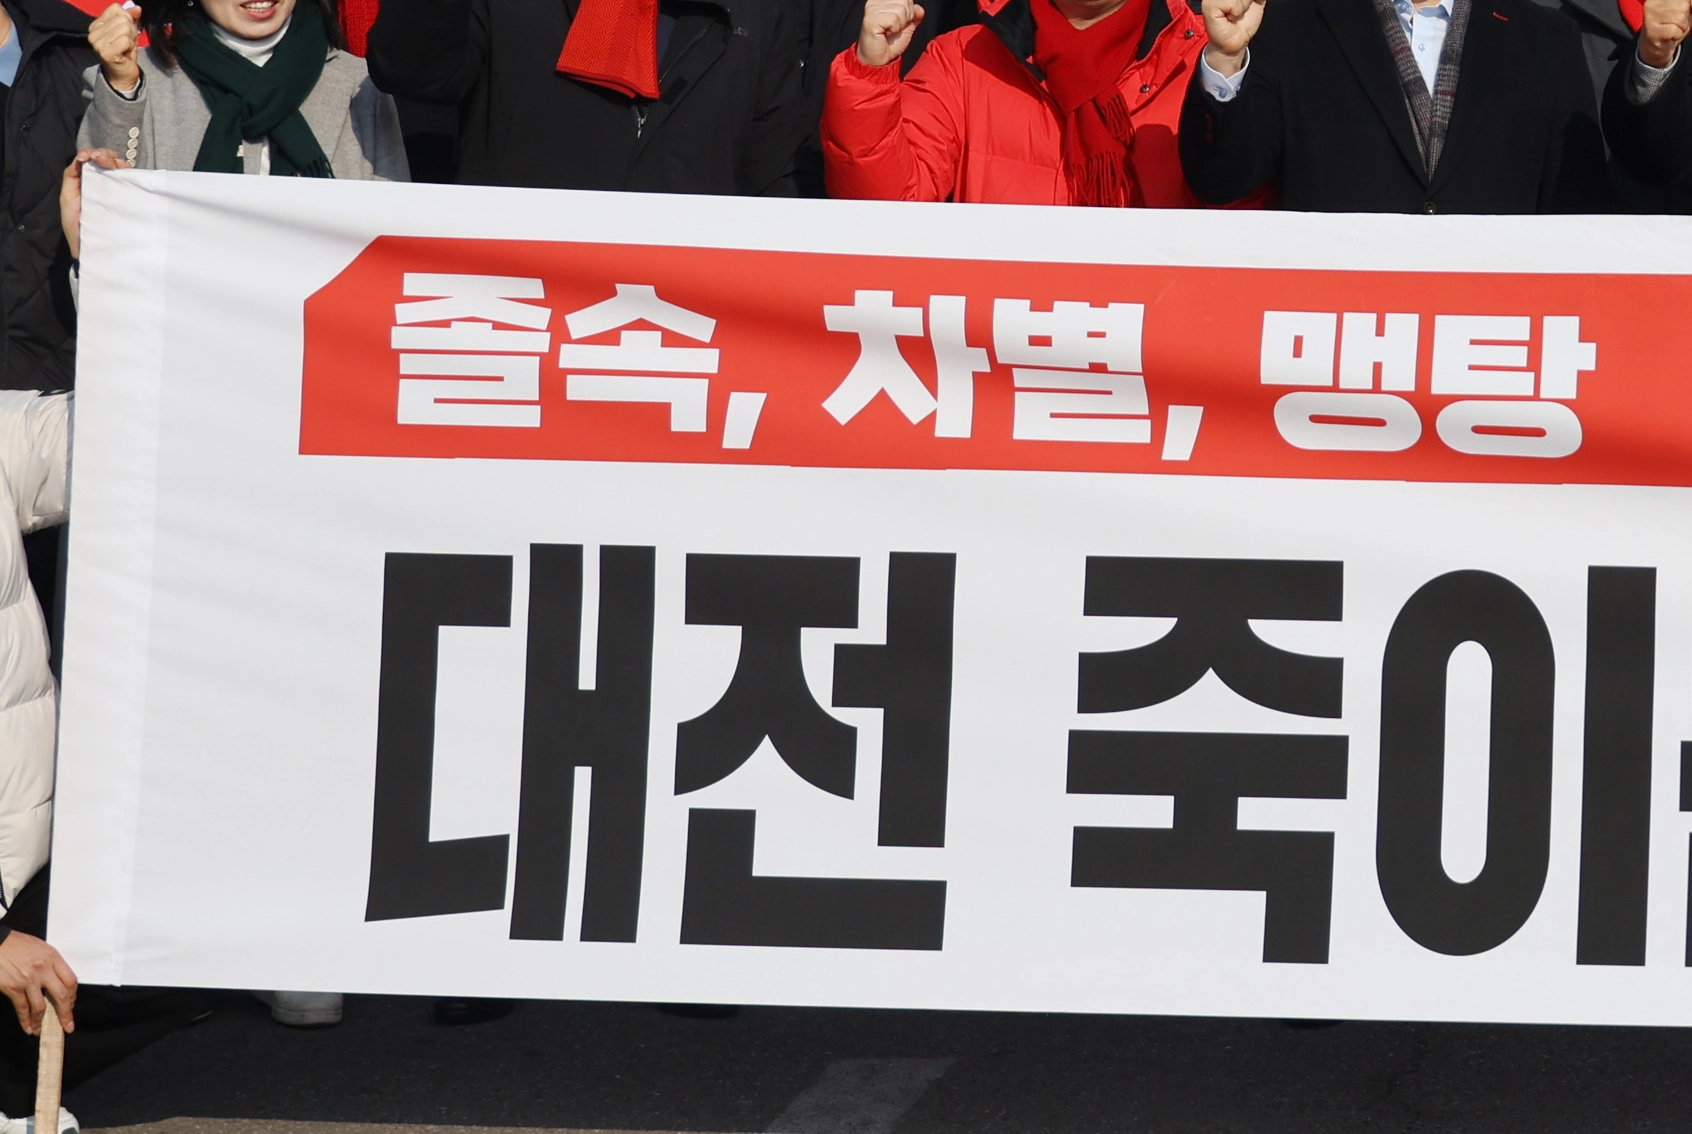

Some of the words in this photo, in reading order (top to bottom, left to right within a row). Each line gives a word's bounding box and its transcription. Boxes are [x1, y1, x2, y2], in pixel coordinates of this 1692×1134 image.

[390, 272, 768, 450] 졸속,
[821, 289, 1204, 461] 차별,
[1260, 310, 1597, 458] 맹탕
[364, 542, 957, 951] 대전
